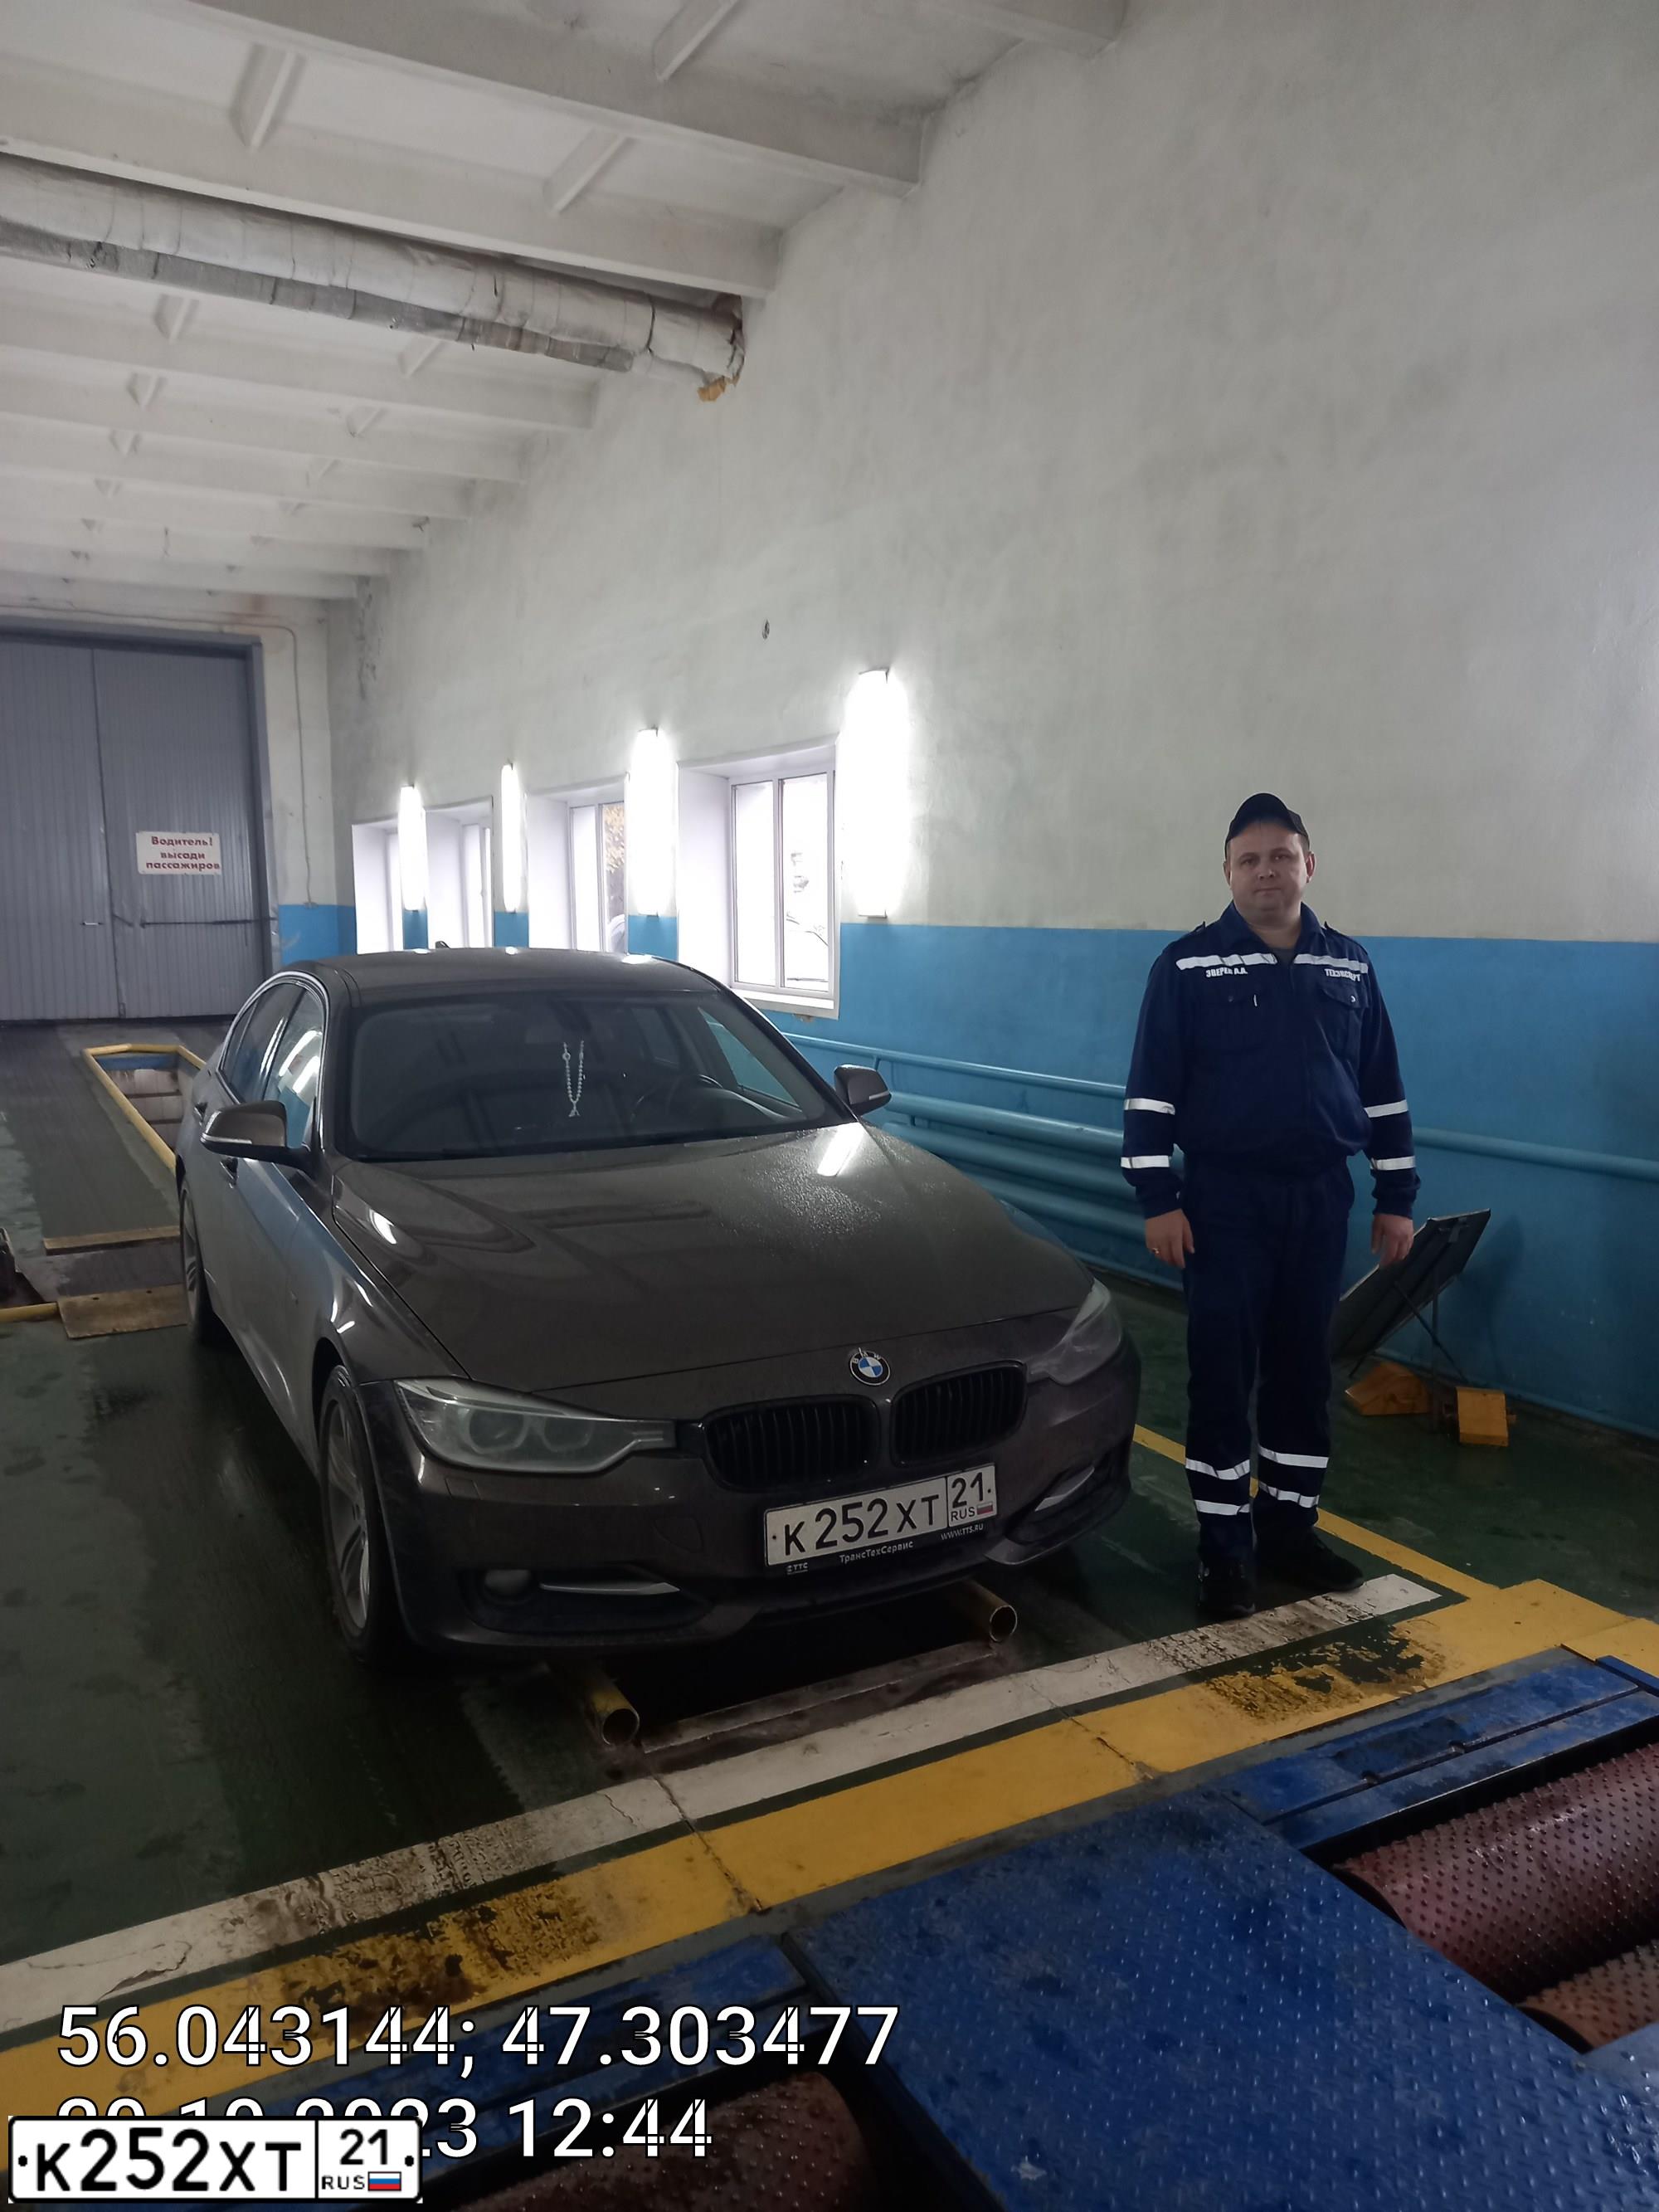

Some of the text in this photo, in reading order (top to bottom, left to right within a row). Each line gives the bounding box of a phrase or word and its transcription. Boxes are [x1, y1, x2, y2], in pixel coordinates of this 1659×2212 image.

[151, 836, 213, 846] Водитель!
[160, 852, 205, 860] высади
[145, 862, 221, 872] пассажиров
[784, 1471, 985, 1557] К252ХТ 21
[951, 1505, 976, 1522] RUS
[839, 1541, 914, 1564] ТрансТехСервис
